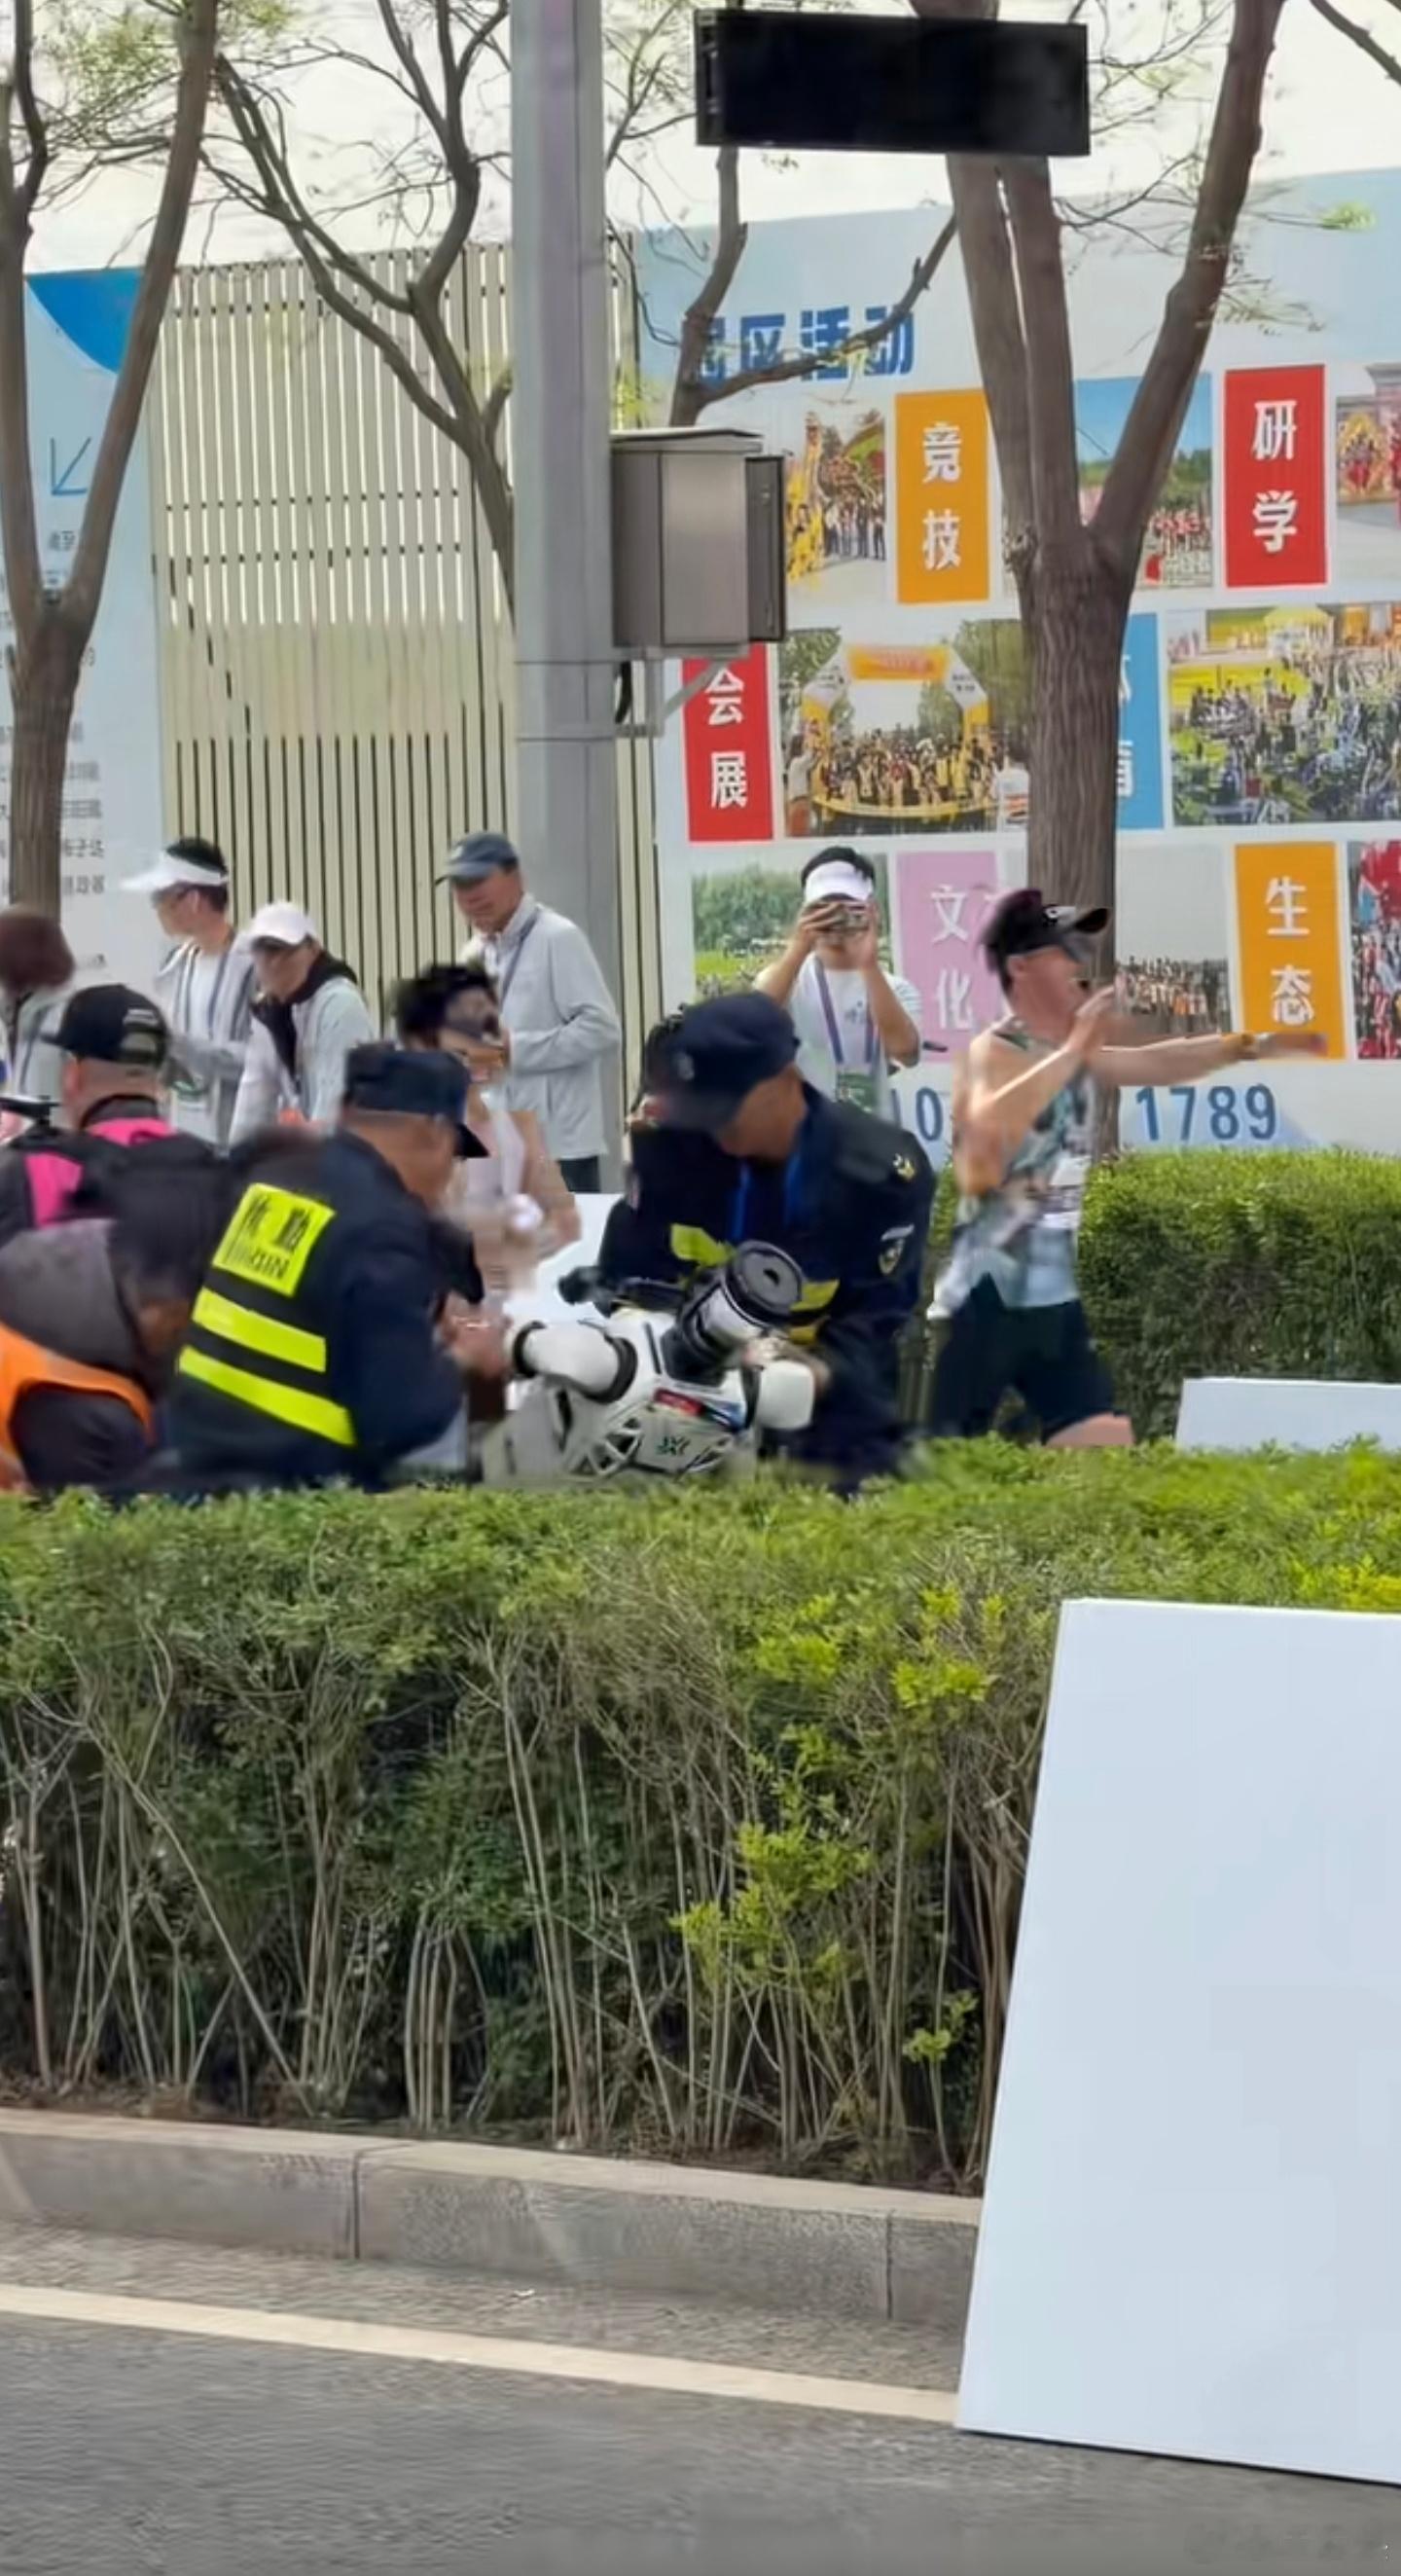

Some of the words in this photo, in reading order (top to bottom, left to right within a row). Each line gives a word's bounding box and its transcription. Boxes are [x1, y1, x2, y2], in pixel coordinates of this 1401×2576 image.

[922, 420, 962, 570] 竞技
[1252, 400, 1298, 553] 研学
[705, 667, 747, 808] 会展
[930, 883, 971, 1030] 文化
[1266, 875, 1313, 1026] 生态
[1135, 1084, 1277, 1142] 1789
